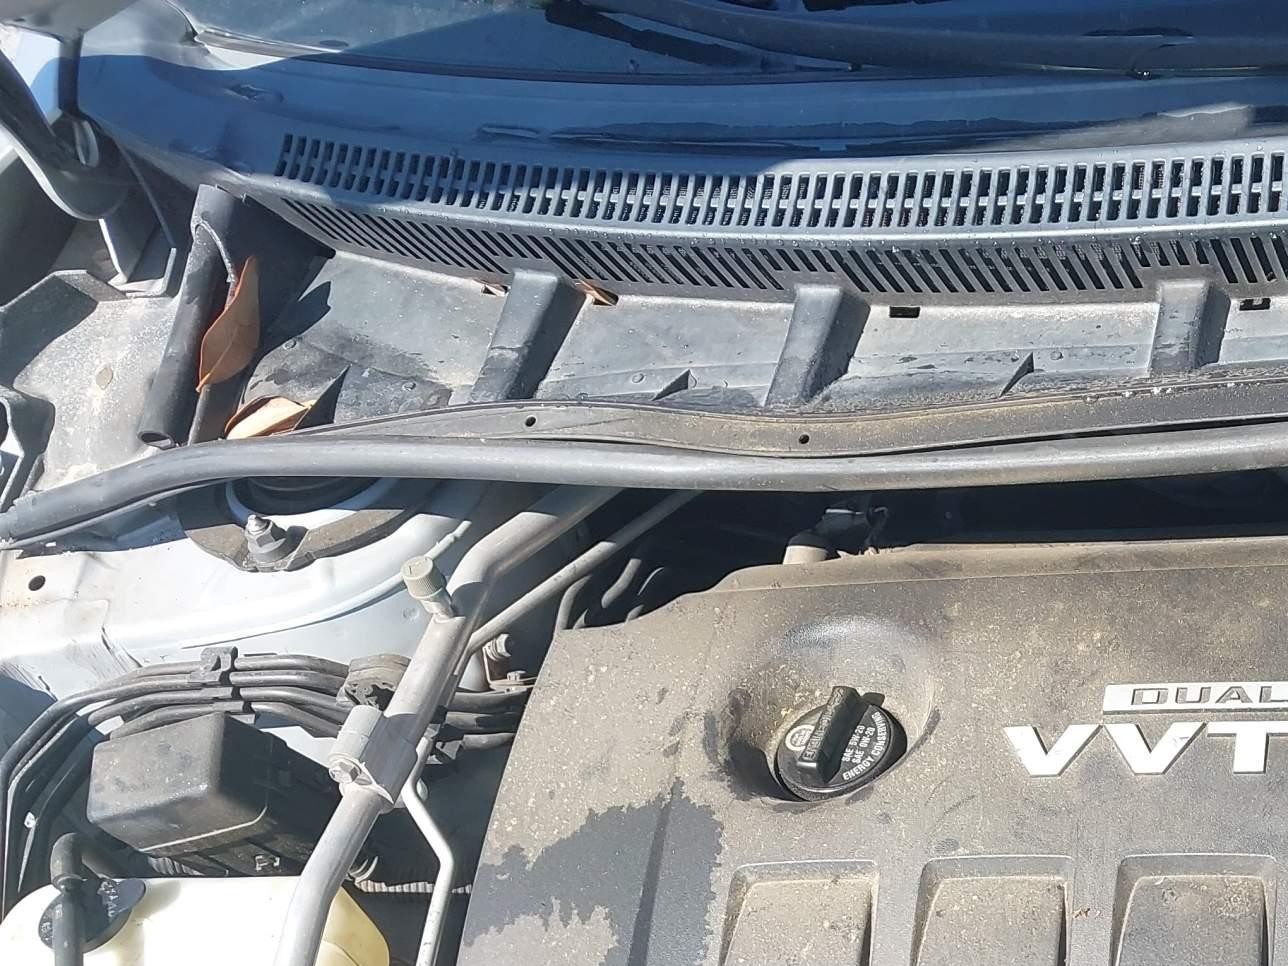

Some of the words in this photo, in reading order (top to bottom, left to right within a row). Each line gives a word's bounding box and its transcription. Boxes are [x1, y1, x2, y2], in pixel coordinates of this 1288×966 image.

[842, 756, 875, 780] ENERGY
[872, 712, 887, 756] CONSERVING
[842, 747, 854, 762] SAE
[852, 750, 865, 763] SAE
[859, 727, 876, 748] 0W-20
